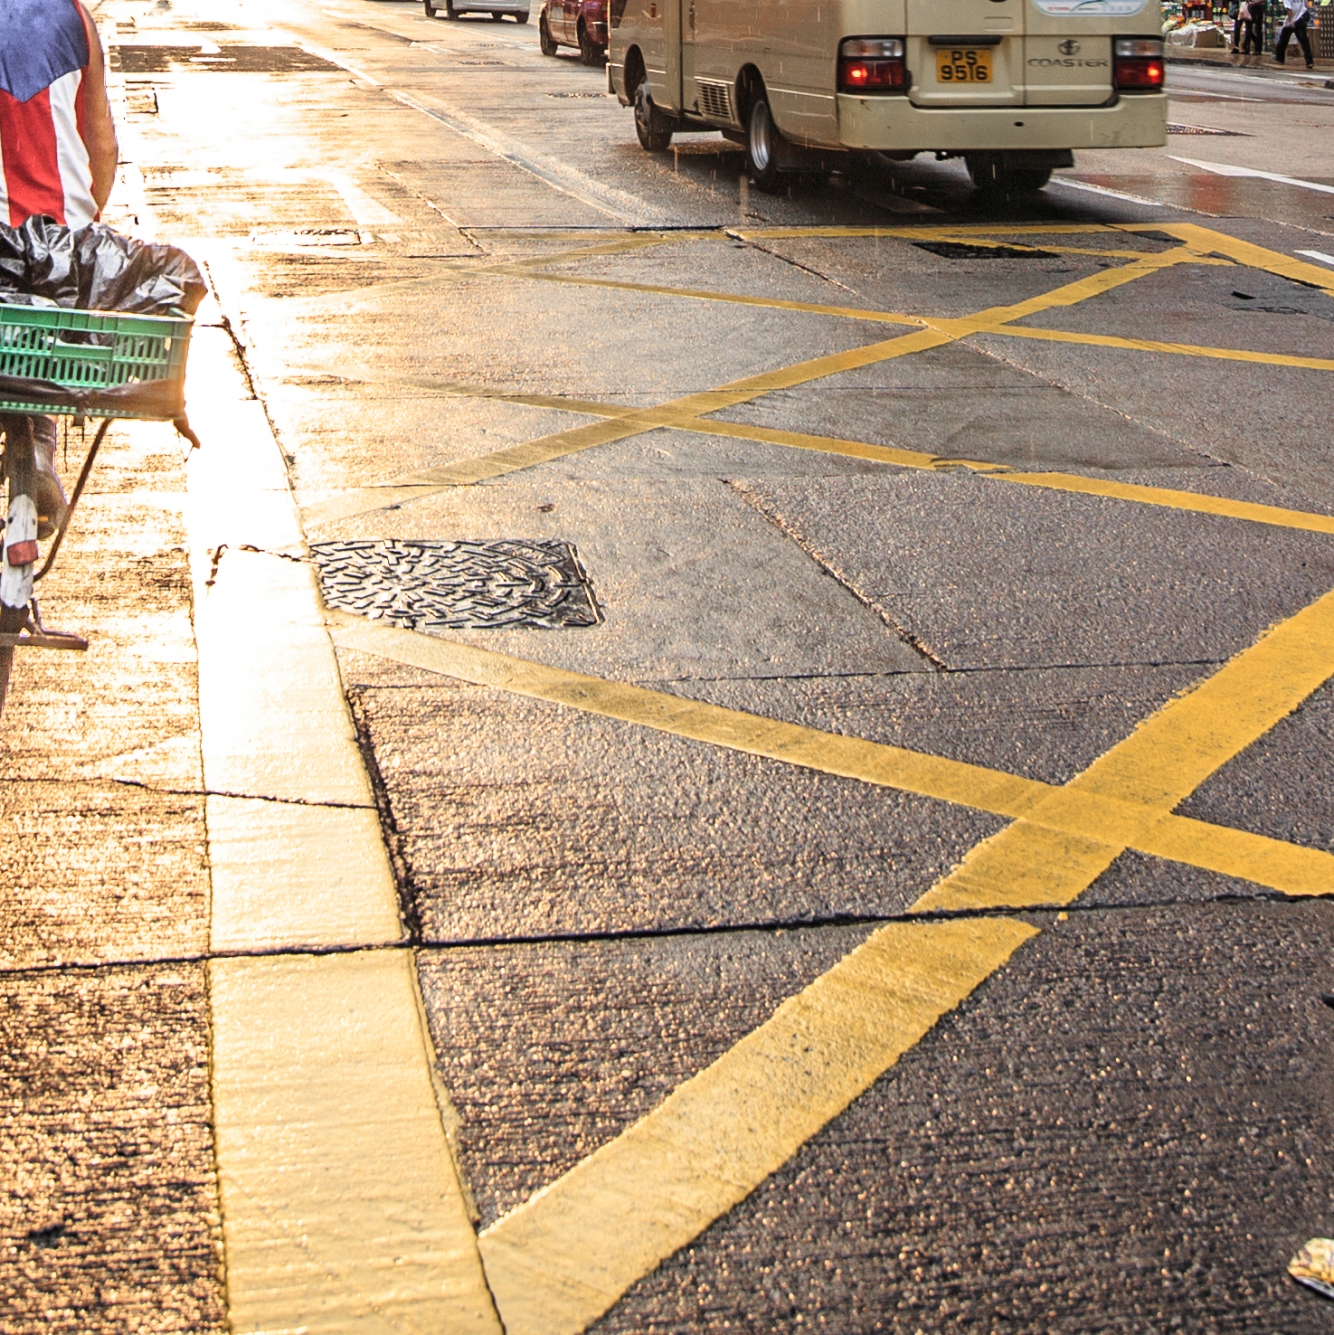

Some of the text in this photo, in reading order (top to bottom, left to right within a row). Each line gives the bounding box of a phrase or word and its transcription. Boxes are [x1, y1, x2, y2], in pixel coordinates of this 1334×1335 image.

[951, 51, 978, 65] PS
[1028, 58, 1109, 68] COASTER
[940, 64, 987, 81] 9516
